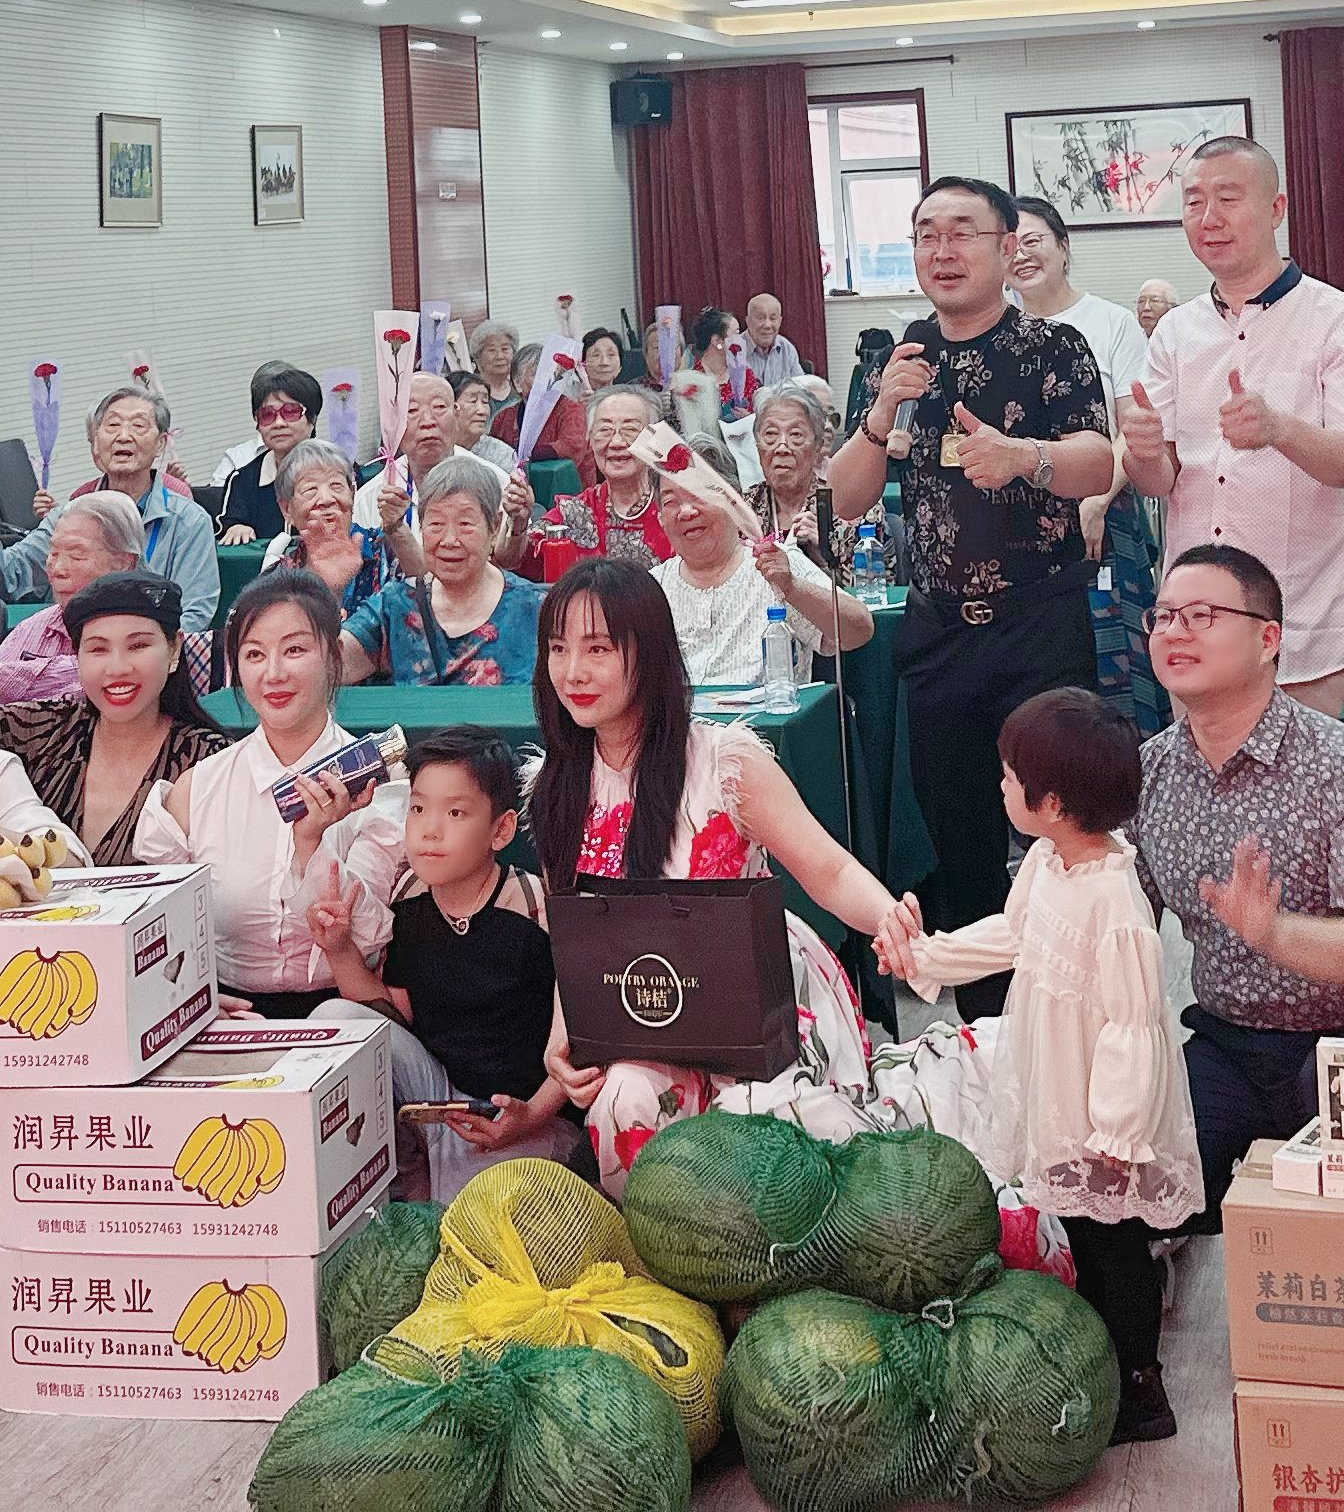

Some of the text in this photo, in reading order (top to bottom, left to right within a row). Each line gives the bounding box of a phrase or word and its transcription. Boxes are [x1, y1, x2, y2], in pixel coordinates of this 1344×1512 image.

[146, 992, 209, 1051] Quality Banana
[3, 1054, 90, 1068] 15931242748
[13, 1114, 154, 1151] 润昇果业
[25, 1172, 174, 1195] Quality Banana
[98, 1221, 183, 1235] 15110527463
[193, 1223, 279, 1237] 15931242748
[11, 1276, 154, 1315] 润昇果业
[23, 1334, 174, 1359] Quality Banana
[97, 1385, 183, 1400] 15110527463
[193, 1387, 280, 1402] 15931242748
